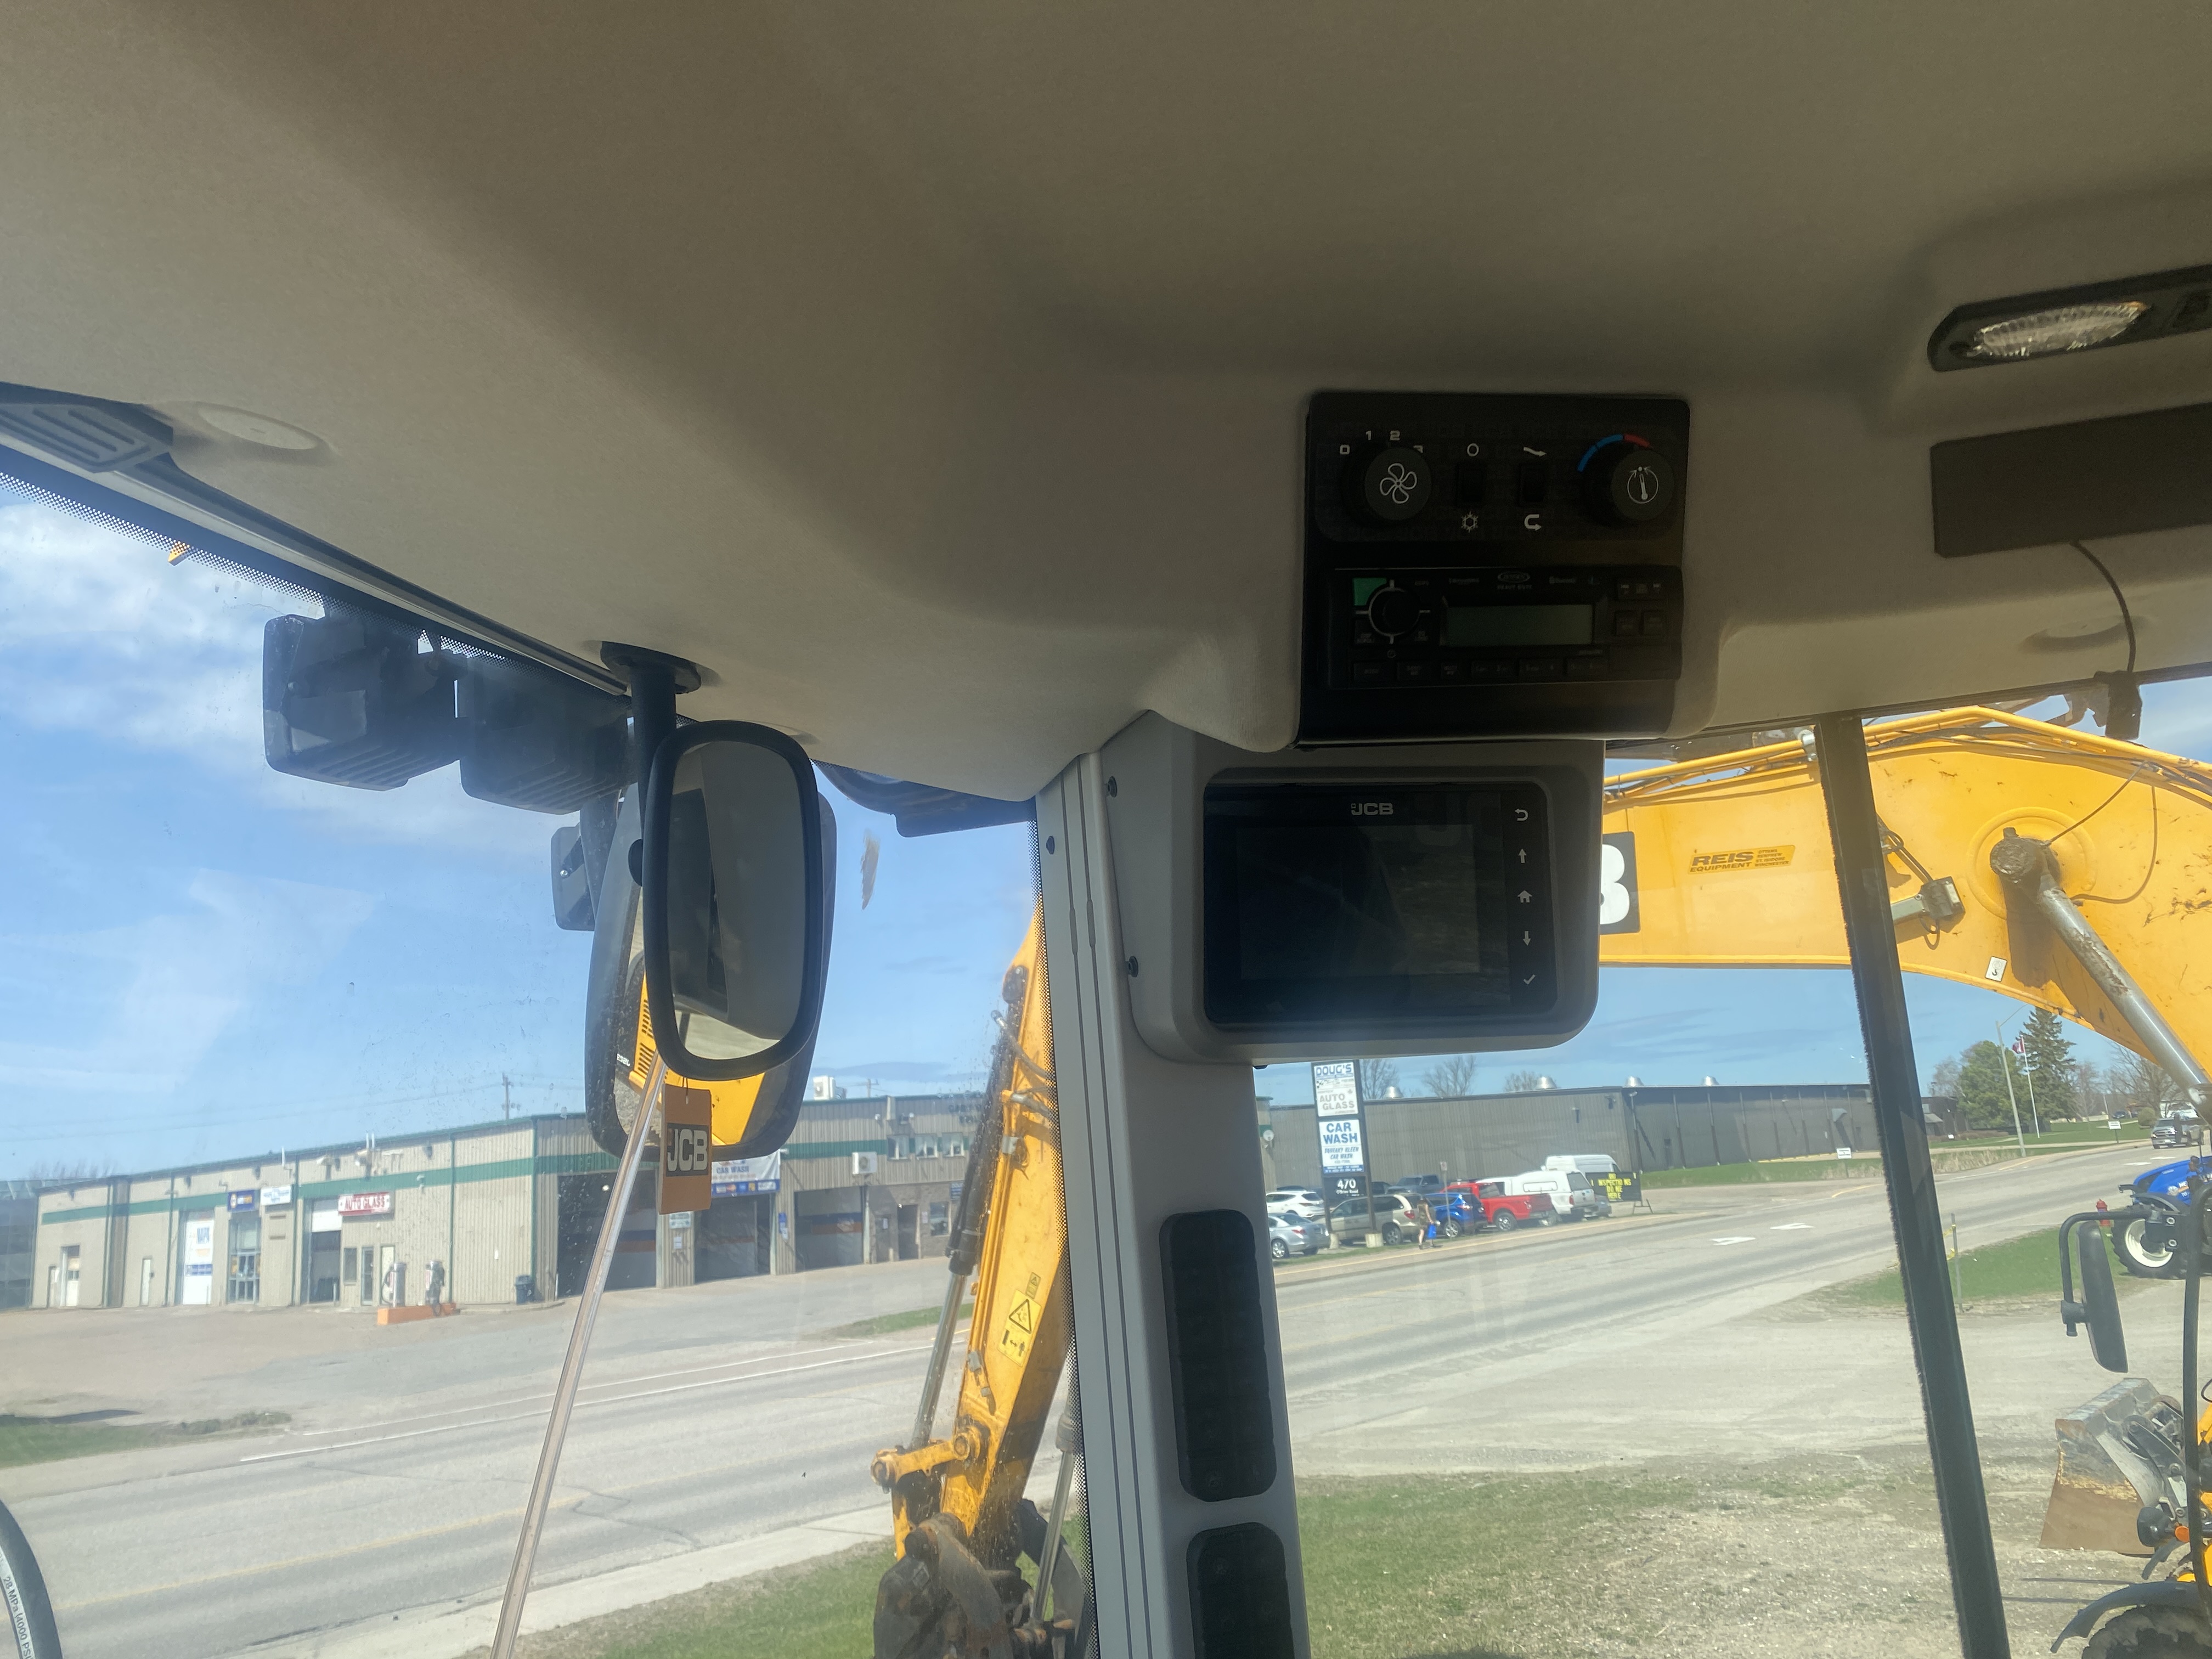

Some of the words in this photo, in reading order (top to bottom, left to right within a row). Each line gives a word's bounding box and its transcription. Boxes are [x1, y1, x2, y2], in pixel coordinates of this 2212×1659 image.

[1365, 430, 1372, 441] 1
[1390, 430, 1401, 441] 2
[1351, 803, 1394, 816] JCB
[1692, 851, 1754, 866] REIS
[1690, 861, 1752, 873] EQUIPMENT
[1316, 1064, 1352, 1076] DOUG'S
[1319, 1093, 1345, 1102] AUTO
[1322, 1101, 1355, 1110] GLASS
[1326, 1122, 1352, 1133] CAR
[1323, 1133, 1358, 1144] WASH
[667, 1128, 708, 1172] JCB
[1337, 1178, 1357, 1189] 470
[345, 1198, 362, 1211] AUTO
[363, 1195, 385, 1209] GLASS
[8, 1589, 19, 1612] MPa
[14, 1613, 28, 1640] (4000
[22, 1642, 33, 1659] PSI
